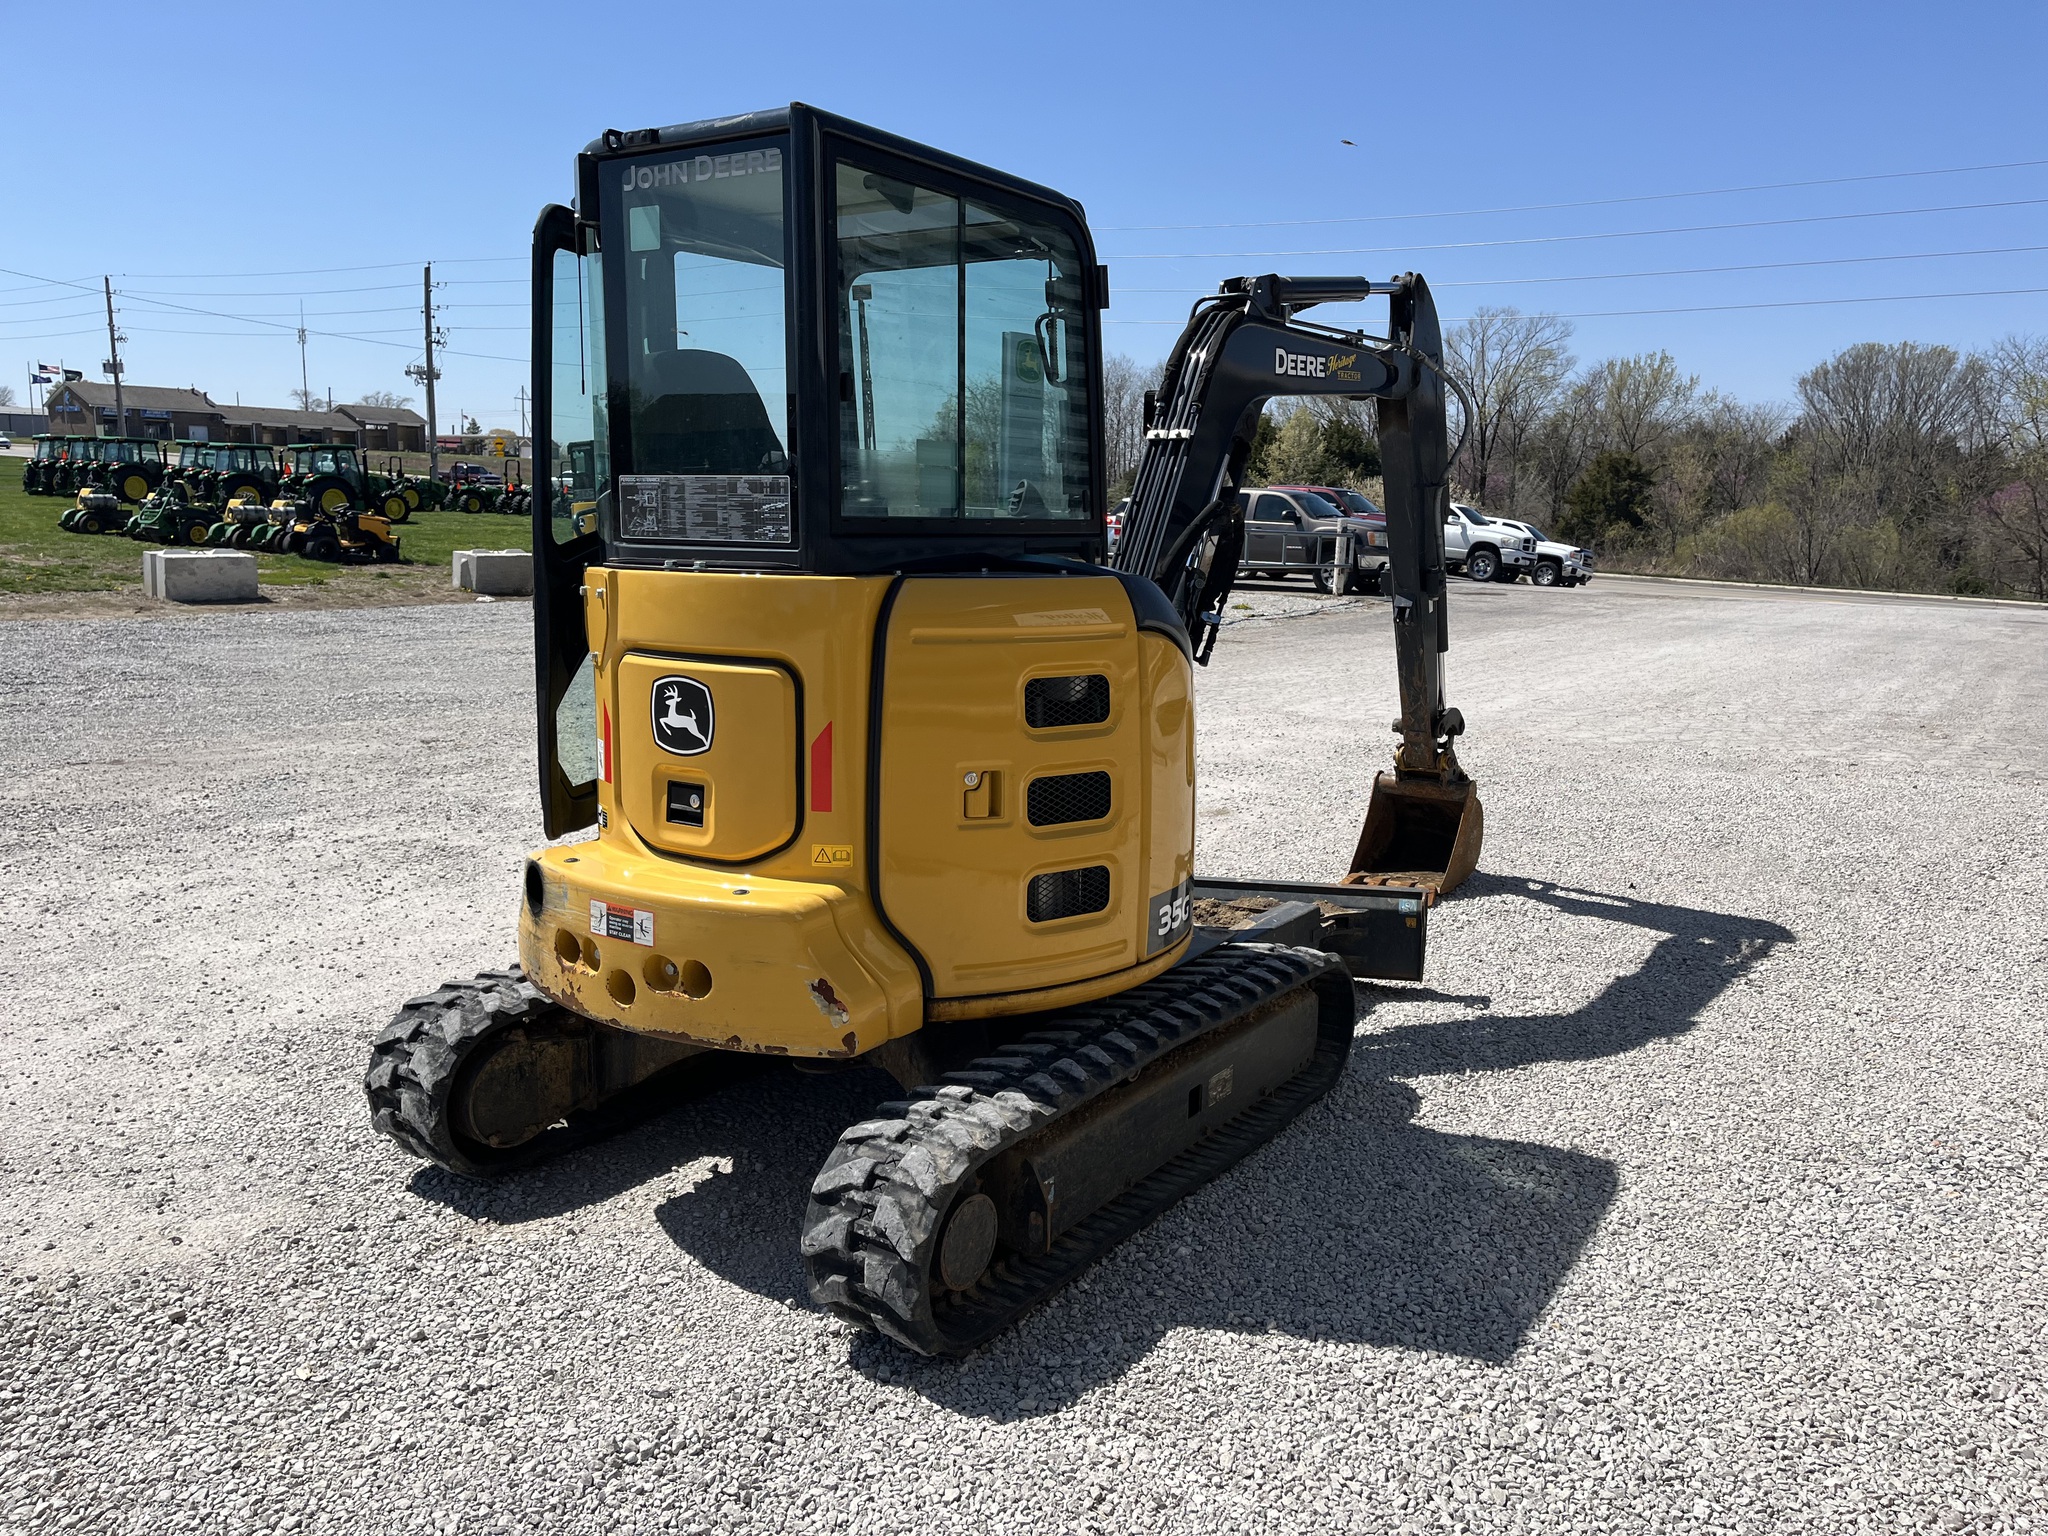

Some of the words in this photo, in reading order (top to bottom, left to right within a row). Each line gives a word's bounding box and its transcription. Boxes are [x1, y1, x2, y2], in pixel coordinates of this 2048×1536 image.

[623, 162, 688, 192] JOHN
[694, 147, 781, 182] DEERE
[1275, 347, 1326, 378] DEERE
[1326, 353, 1357, 376] Heritage
[1337, 371, 1361, 380] TRACTOR
[1158, 895, 1190, 936] 35G
